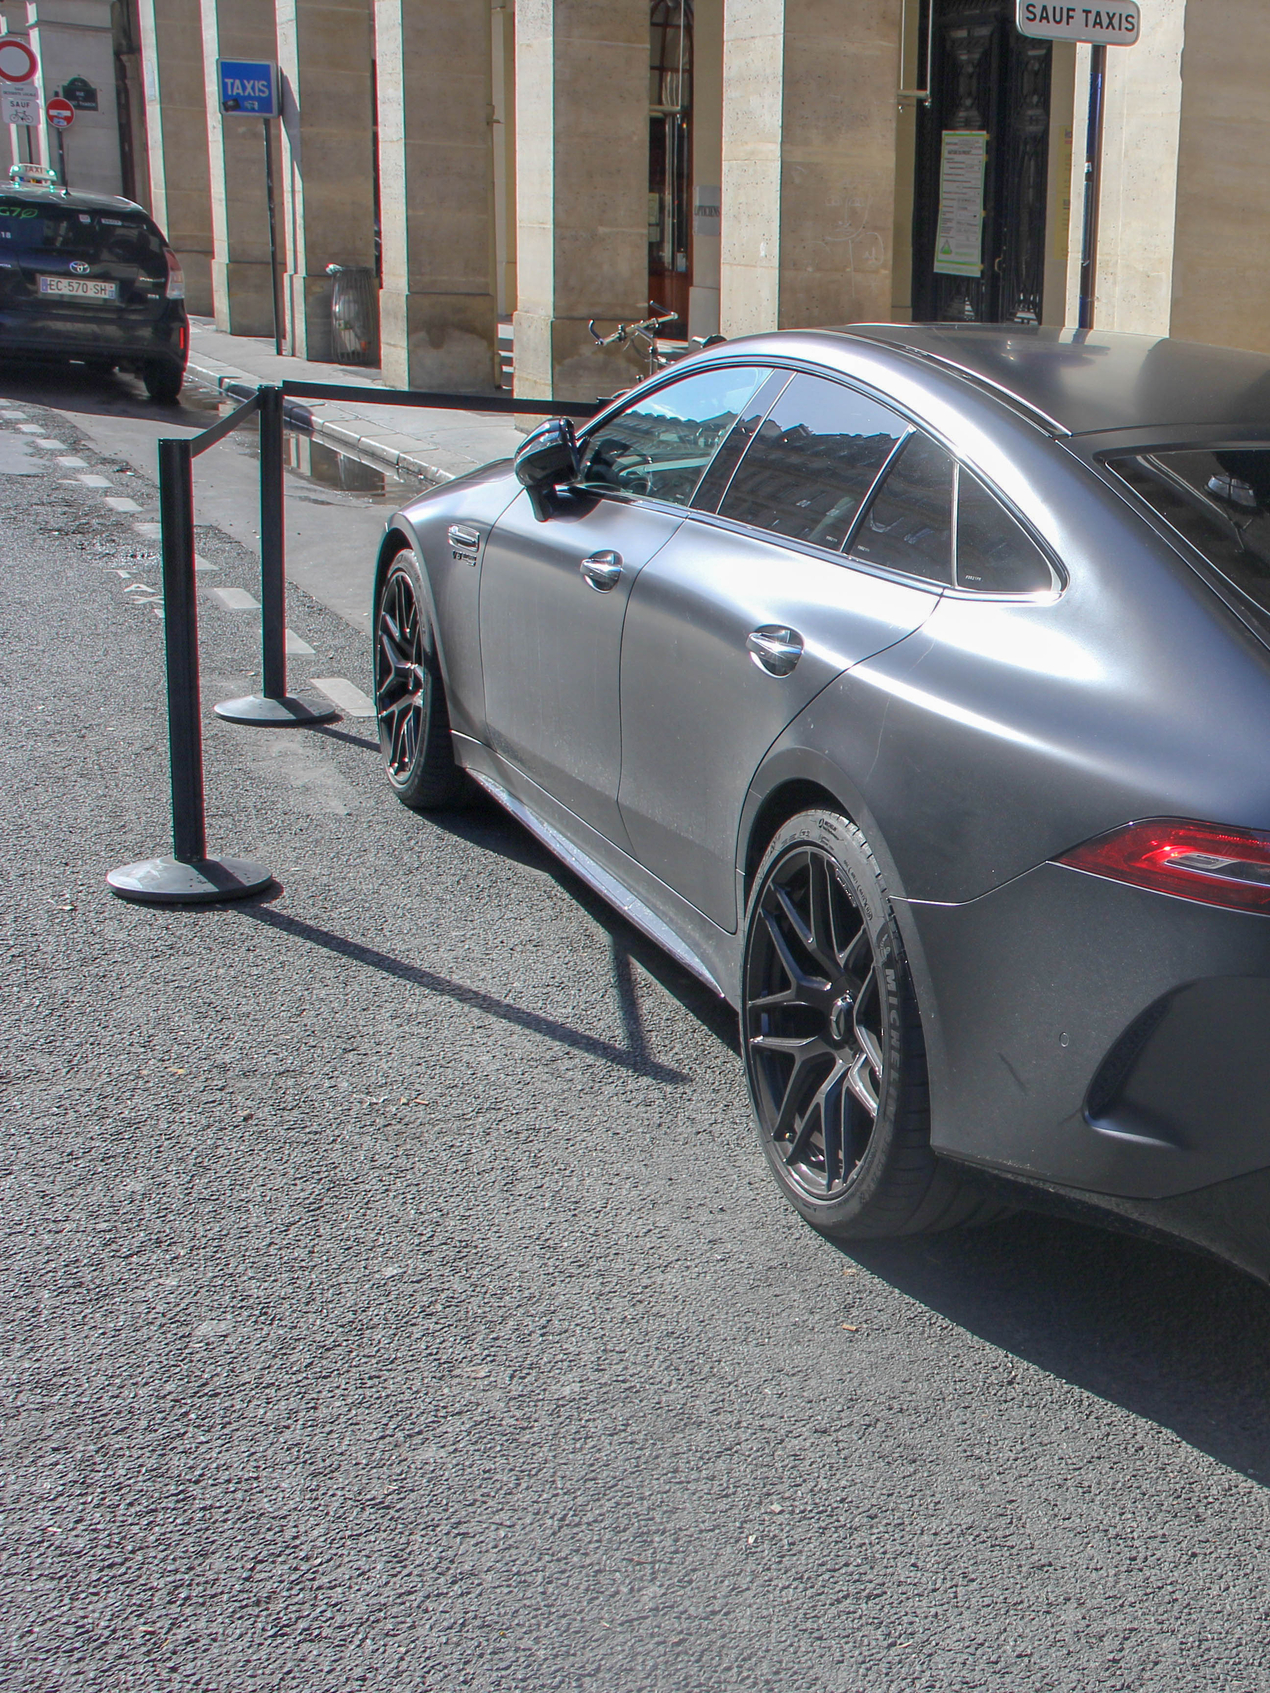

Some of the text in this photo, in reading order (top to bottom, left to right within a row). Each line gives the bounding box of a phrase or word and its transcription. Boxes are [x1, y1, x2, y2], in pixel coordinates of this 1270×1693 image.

[1025, 3, 1136, 33] SAUF TAXIS
[224, 78, 270, 97] TAXIS
[10, 100, 30, 108] SAUF
[24, 166, 43, 174] TAXI
[48, 279, 107, 296] EC-570-SH
